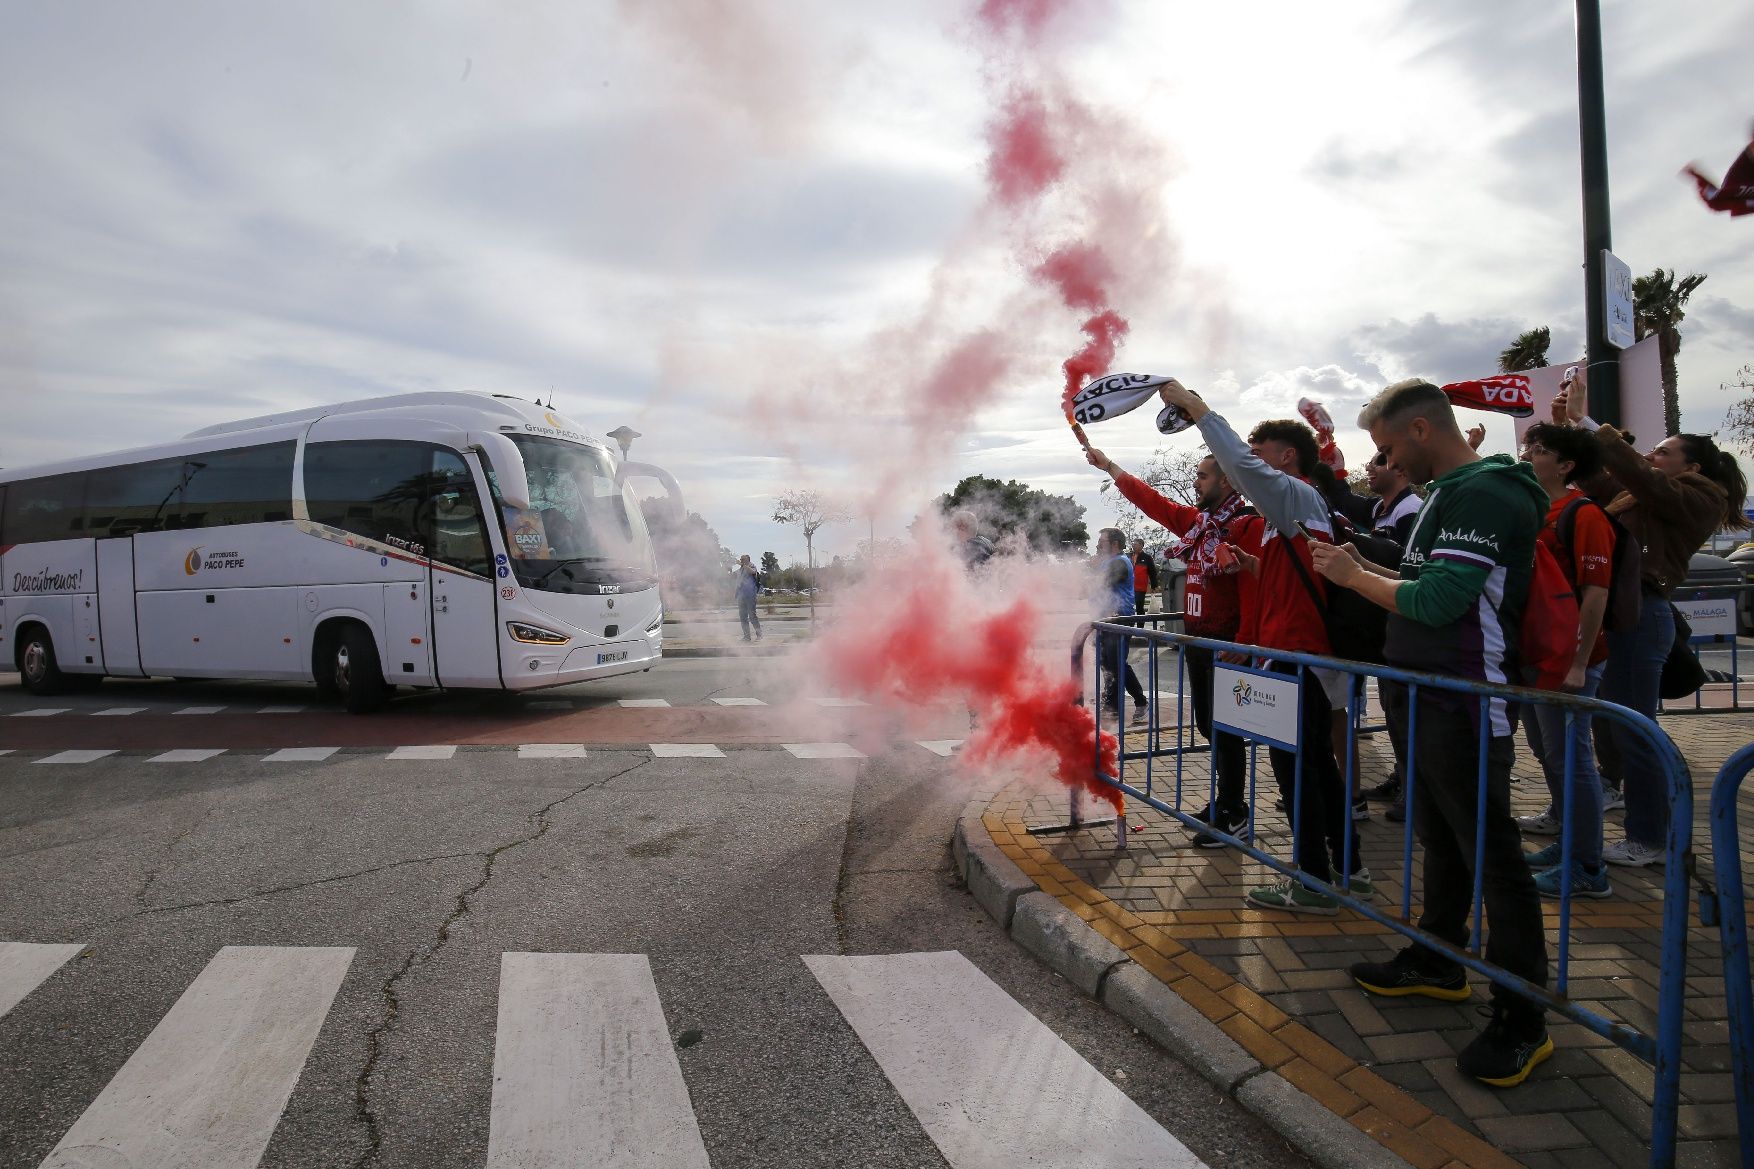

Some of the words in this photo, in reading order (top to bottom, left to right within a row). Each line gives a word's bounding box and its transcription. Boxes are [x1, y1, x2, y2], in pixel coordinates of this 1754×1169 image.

[525, 423, 554, 435] Grupo
[556, 428, 579, 440] PACO
[514, 534, 541, 544] BAXI
[1439, 527, 1499, 553] Andalucía
[209, 551, 239, 559] AUTOBUSES
[1403, 547, 1425, 564] aja
[204, 560, 223, 570] PACO
[225, 558, 244, 569] PEPE
[13, 567, 83, 593] Descúbrenos!
